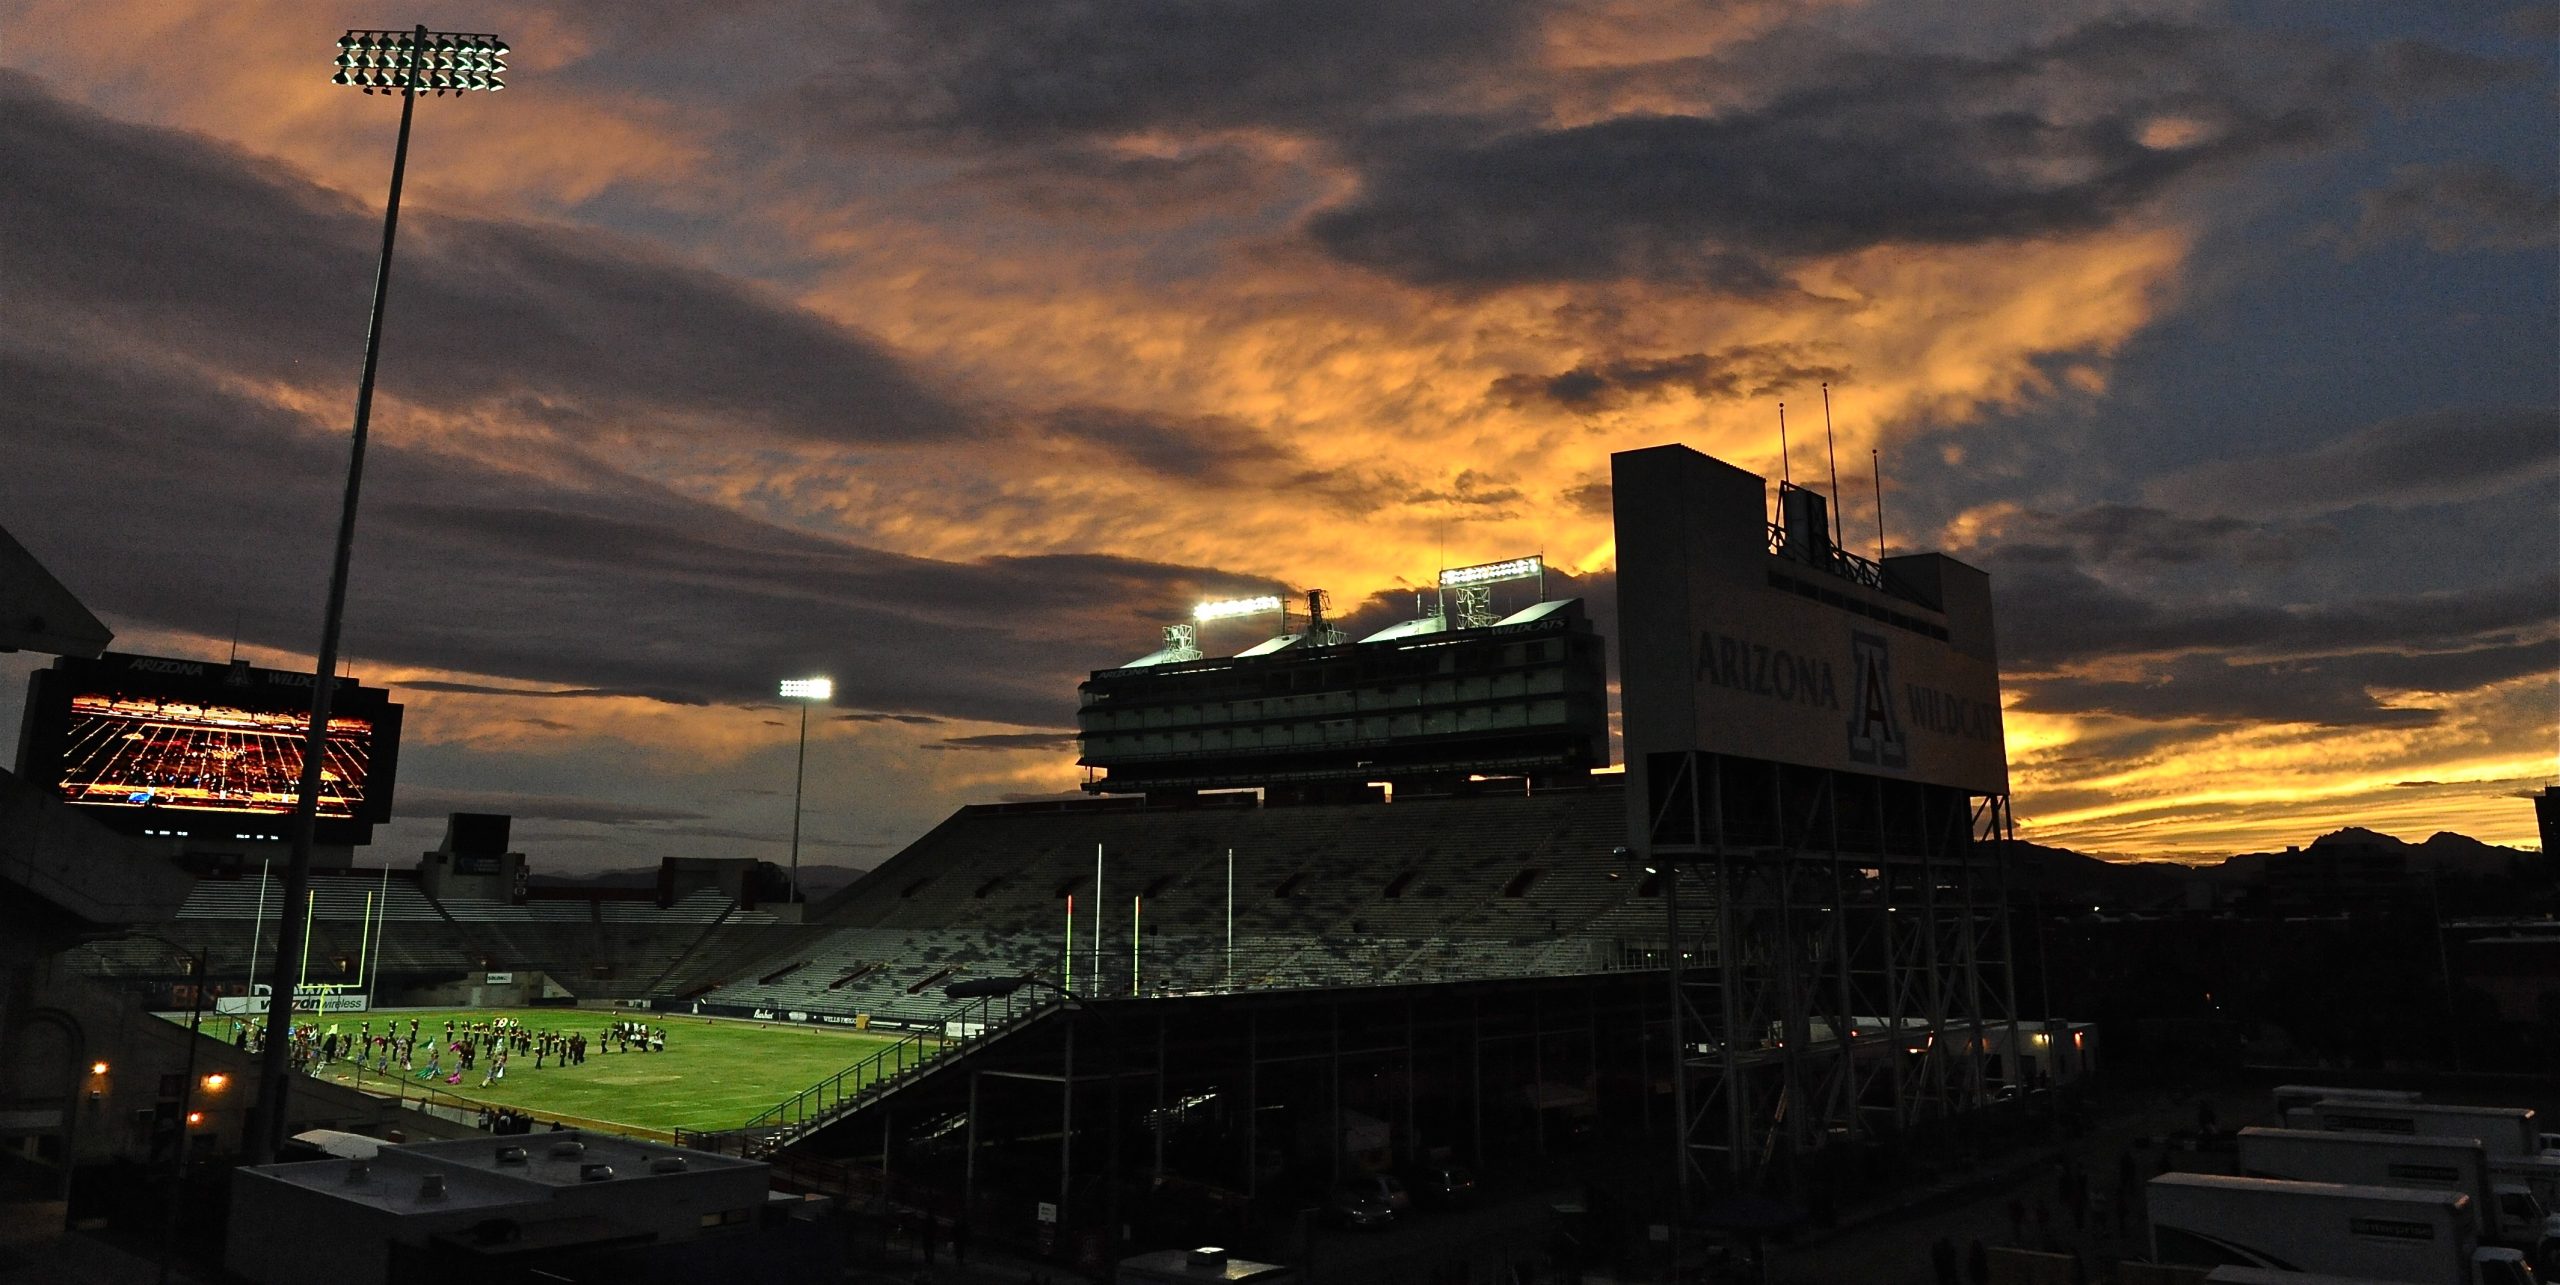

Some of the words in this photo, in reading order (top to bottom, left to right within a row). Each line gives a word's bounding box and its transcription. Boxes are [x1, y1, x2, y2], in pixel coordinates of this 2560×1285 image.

[1491, 619, 1565, 636] WILDCATS
[129, 656, 205, 677] ARIZONA
[1097, 667, 1149, 679] ARIZONA
[1696, 631, 1839, 710] ARIZONA
